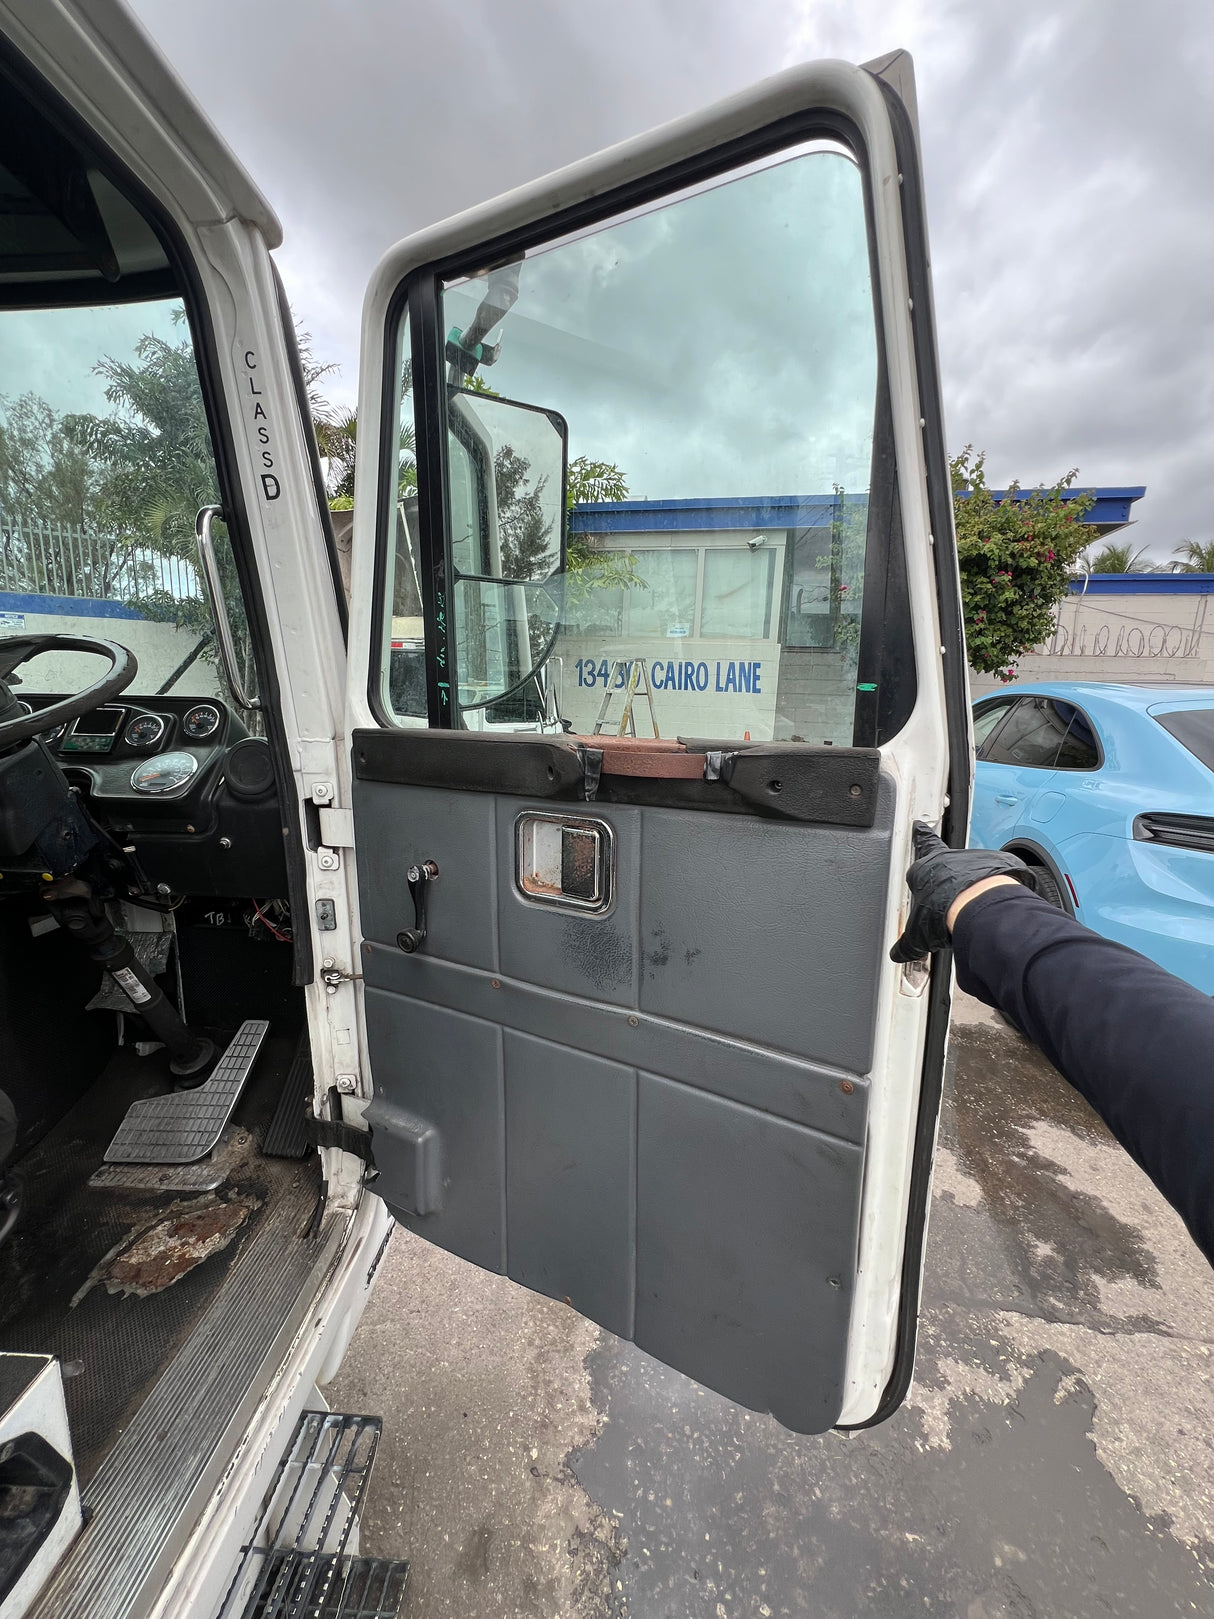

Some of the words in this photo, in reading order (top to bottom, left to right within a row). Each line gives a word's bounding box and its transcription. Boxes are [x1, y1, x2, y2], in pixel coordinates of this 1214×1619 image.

[245, 351, 273, 468] CLASS
[261, 474, 280, 500] D
[651, 661, 709, 691] CAIRO
[715, 661, 761, 693] LANE
